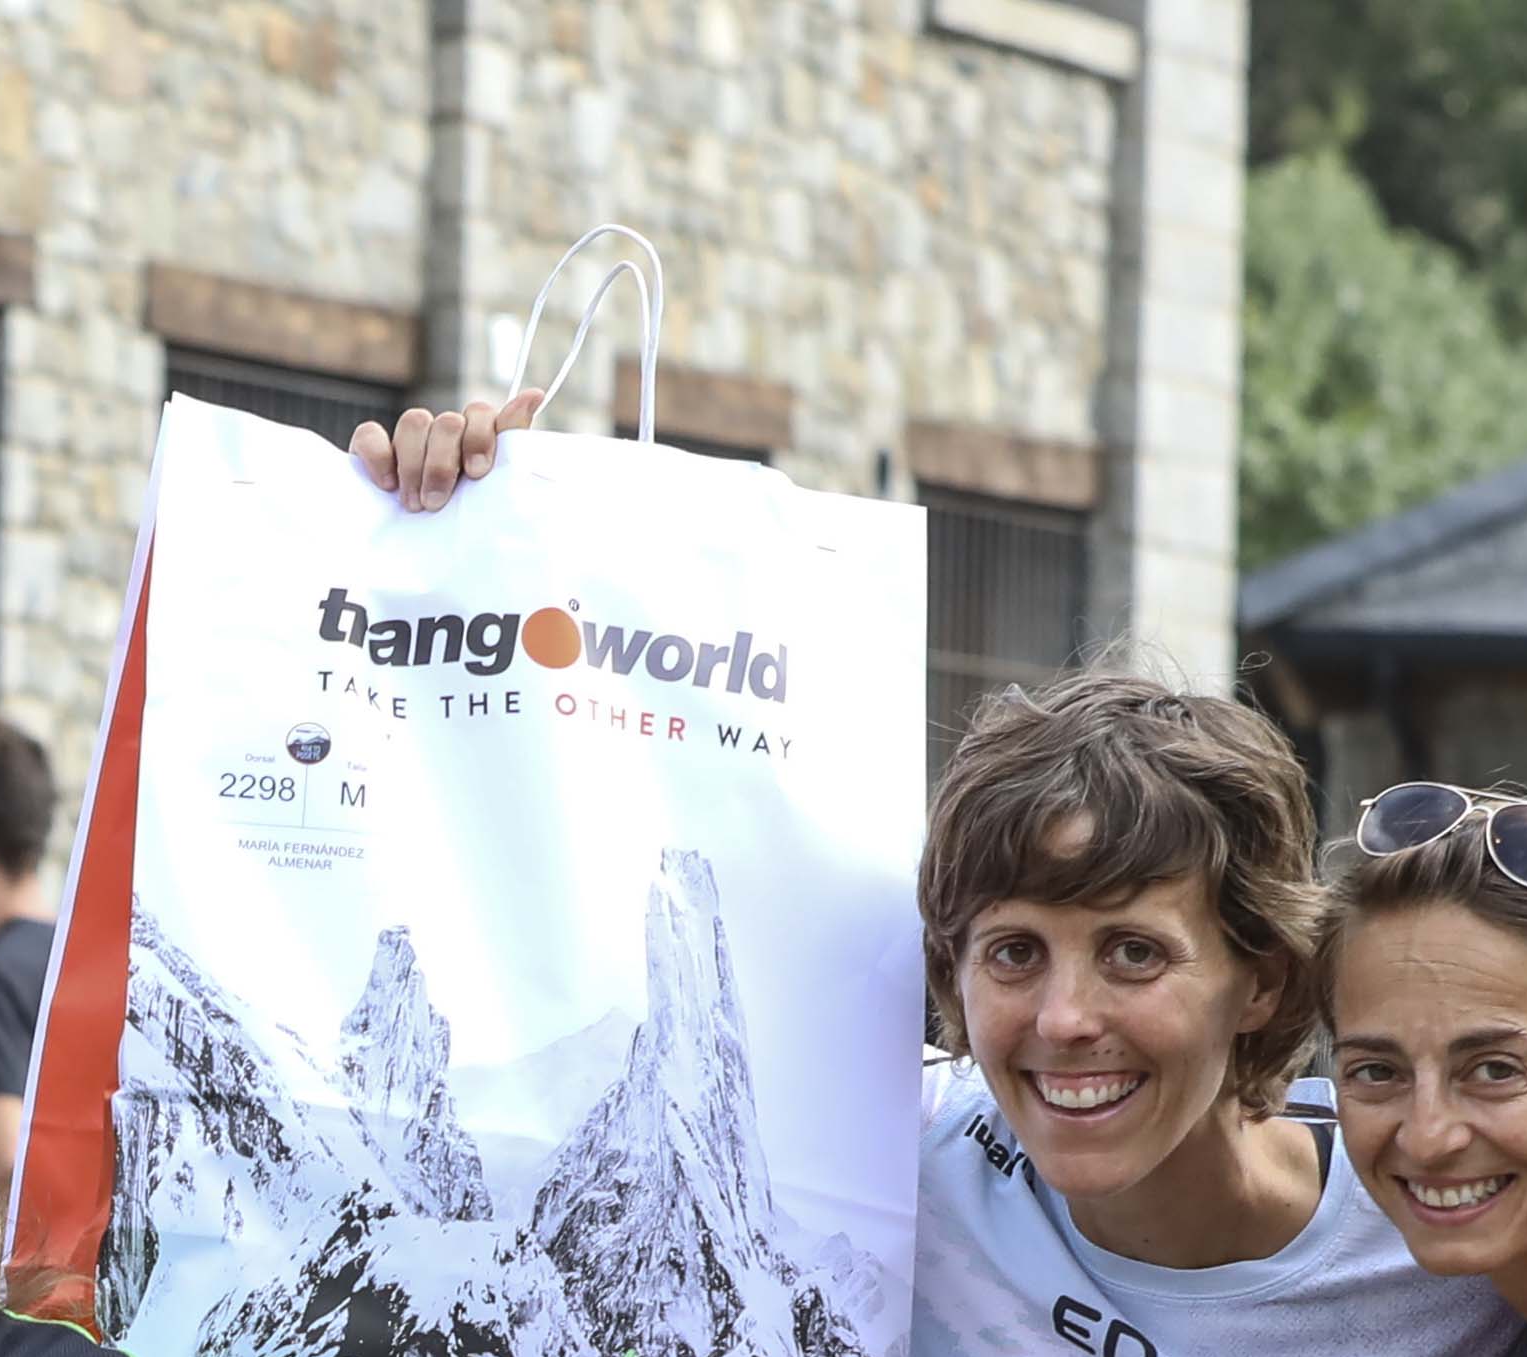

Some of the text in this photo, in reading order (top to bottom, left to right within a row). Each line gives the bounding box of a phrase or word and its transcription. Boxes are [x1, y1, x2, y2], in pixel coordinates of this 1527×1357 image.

[318, 671, 793, 759] TAKE THE OTHER WAY
[245, 753, 276, 763] Dorsal
[219, 773, 365, 807] 2298 M
[238, 839, 364, 859] MARÍA FERNÁNDEZ
[268, 856, 332, 870] ALMENAR
